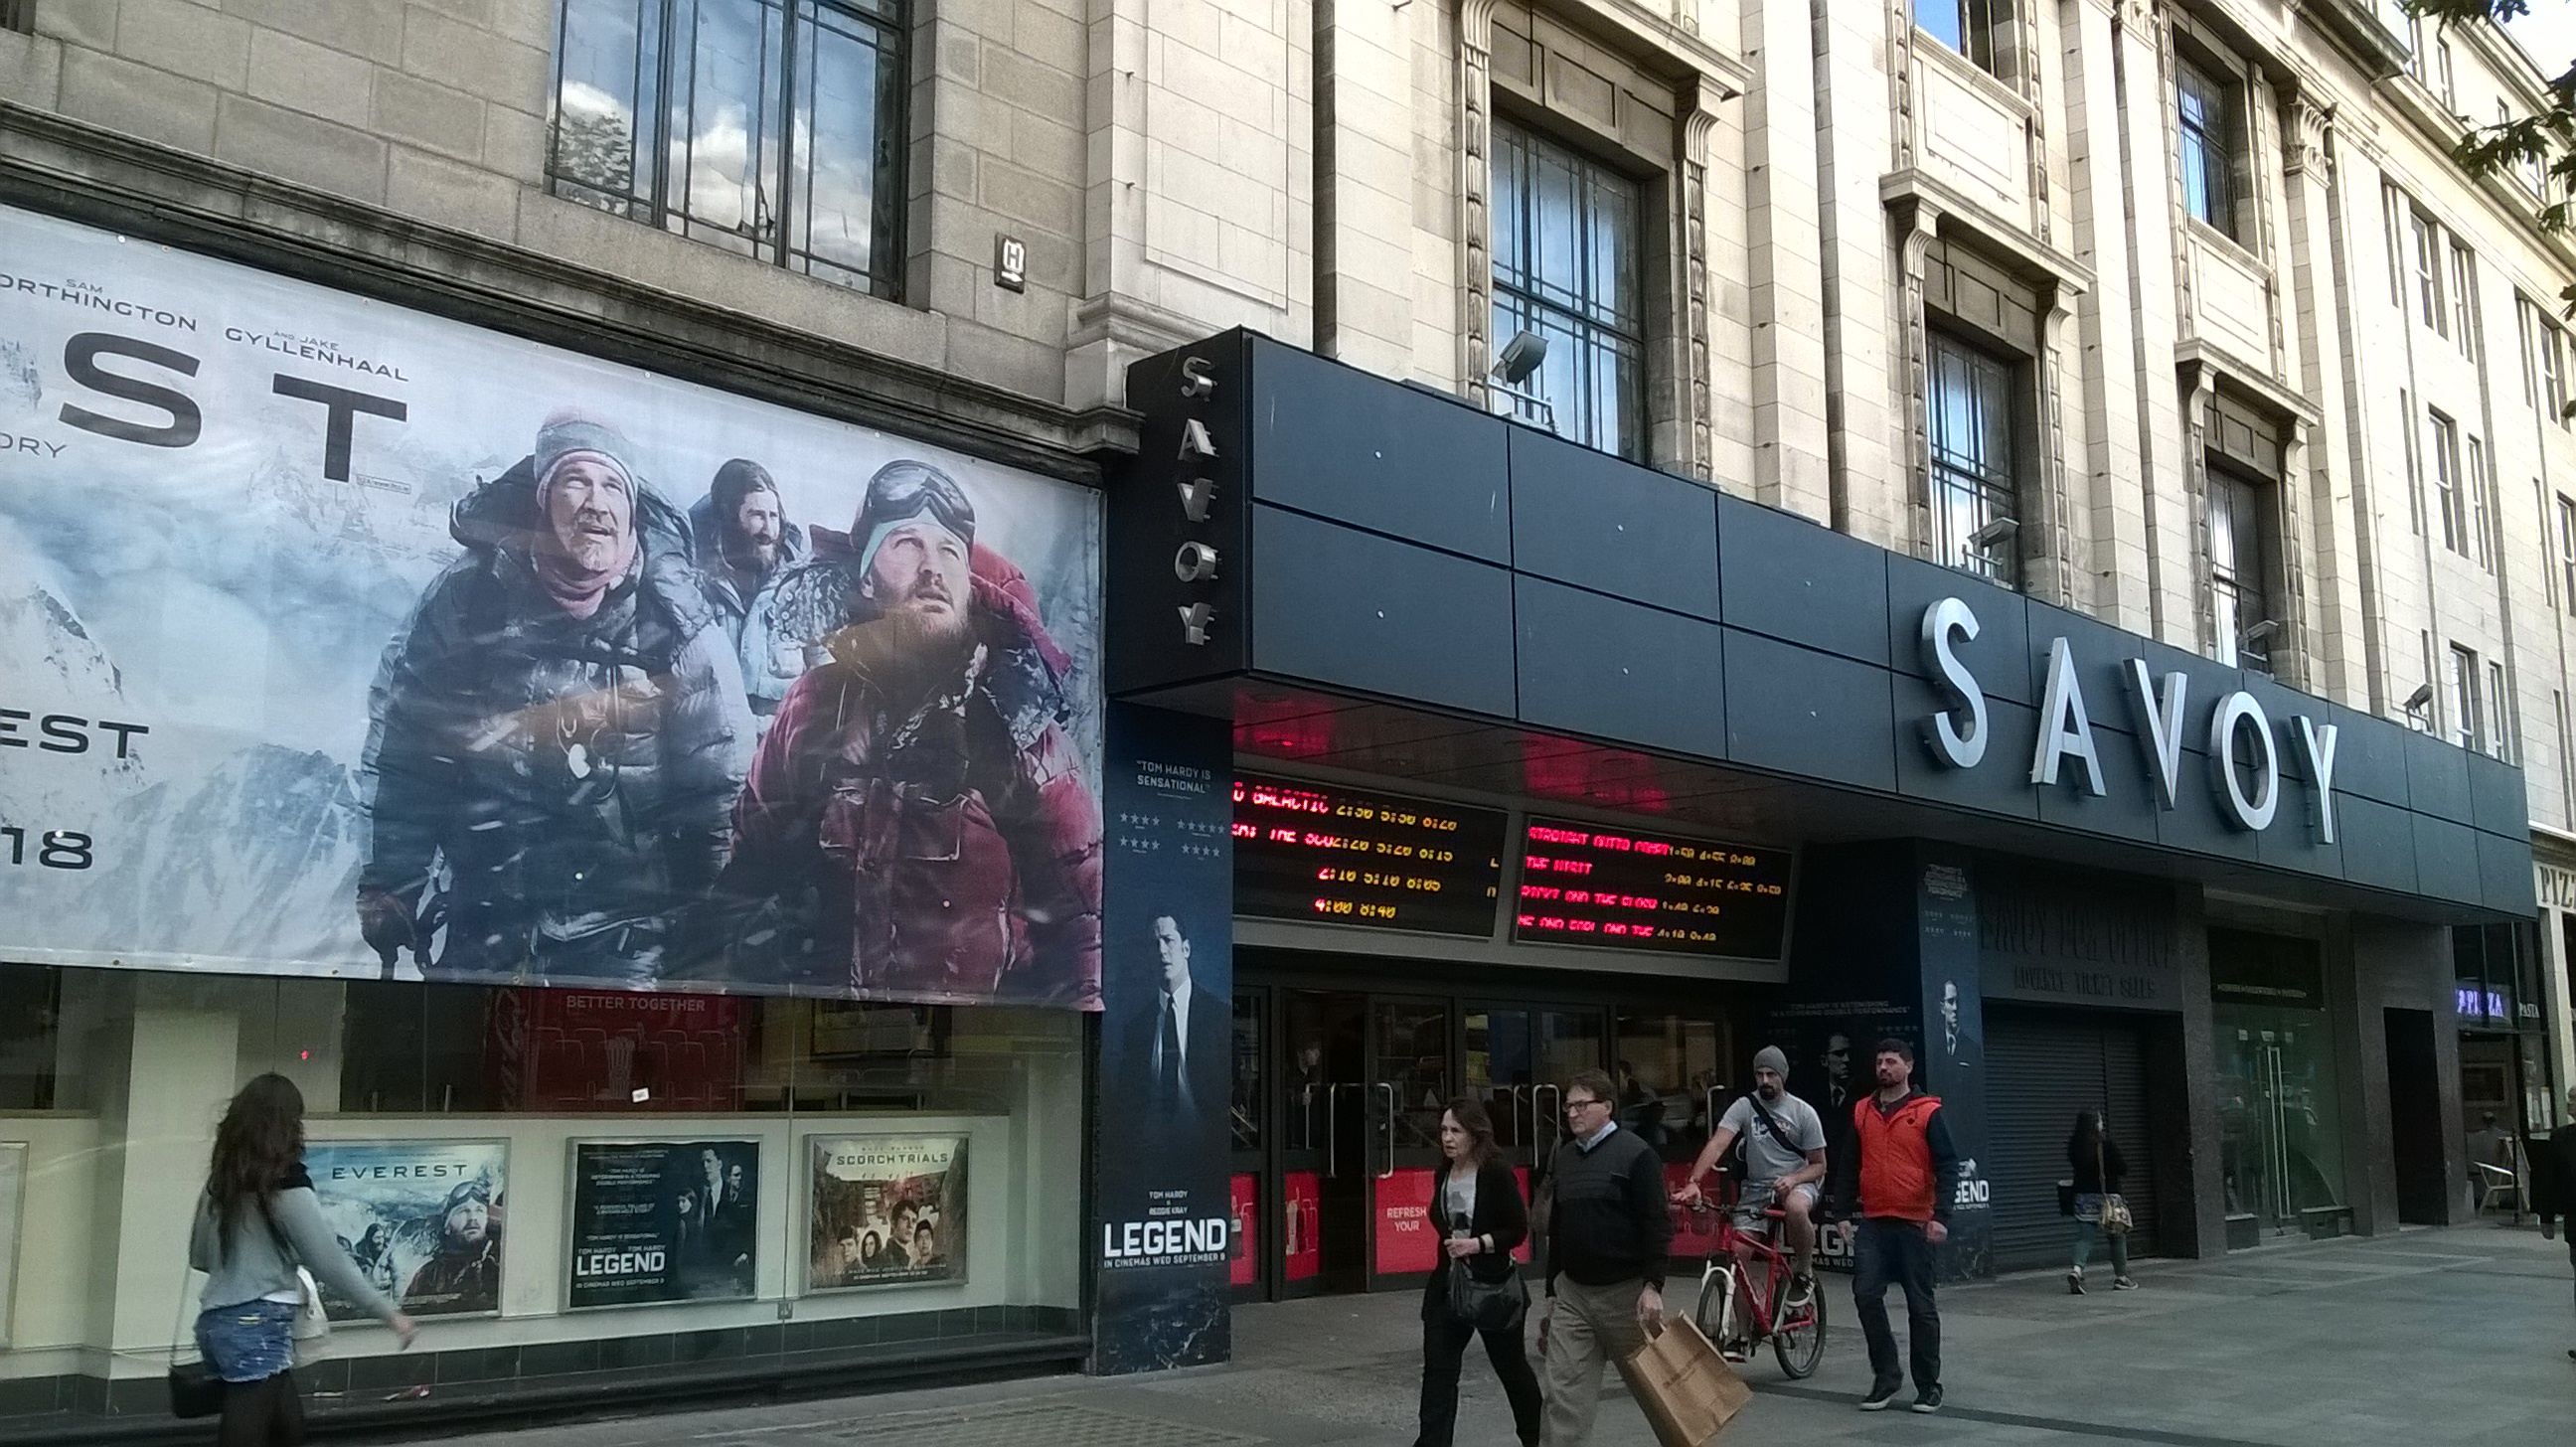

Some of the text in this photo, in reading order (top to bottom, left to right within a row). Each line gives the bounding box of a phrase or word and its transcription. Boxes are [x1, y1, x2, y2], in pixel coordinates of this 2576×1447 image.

[66, 278, 102, 293] SAM
[300, 336, 339, 351] JAKE
[225, 327, 409, 383] GYLLENHAAL
[1175, 356, 1218, 646] SAVOY
[1921, 596, 2338, 846] SAVOY
[0, 708, 150, 759] EST
[1165, 763, 1199, 779] HARDY
[1200, 769, 1211, 781] IS
[1, 827, 93, 871] 18
[2538, 865, 2576, 908] PIZ
[566, 995, 706, 1012] BETTER TOGETHER
[837, 1153, 949, 1166] SCORCH TRIALS
[331, 1164, 468, 1180] EVEREST
[1386, 1206, 1427, 1219] REFRESH
[1394, 1220, 1419, 1232] YOUR
[1104, 1217, 1227, 1258] LEGEND
[575, 1251, 666, 1276] LEGEND
[1103, 1259, 1113, 1269] IN
[1114, 1256, 1151, 1269] CINEMAS
[1153, 1255, 1172, 1266] WED
[1174, 1252, 1219, 1264] SEPTEMBER
